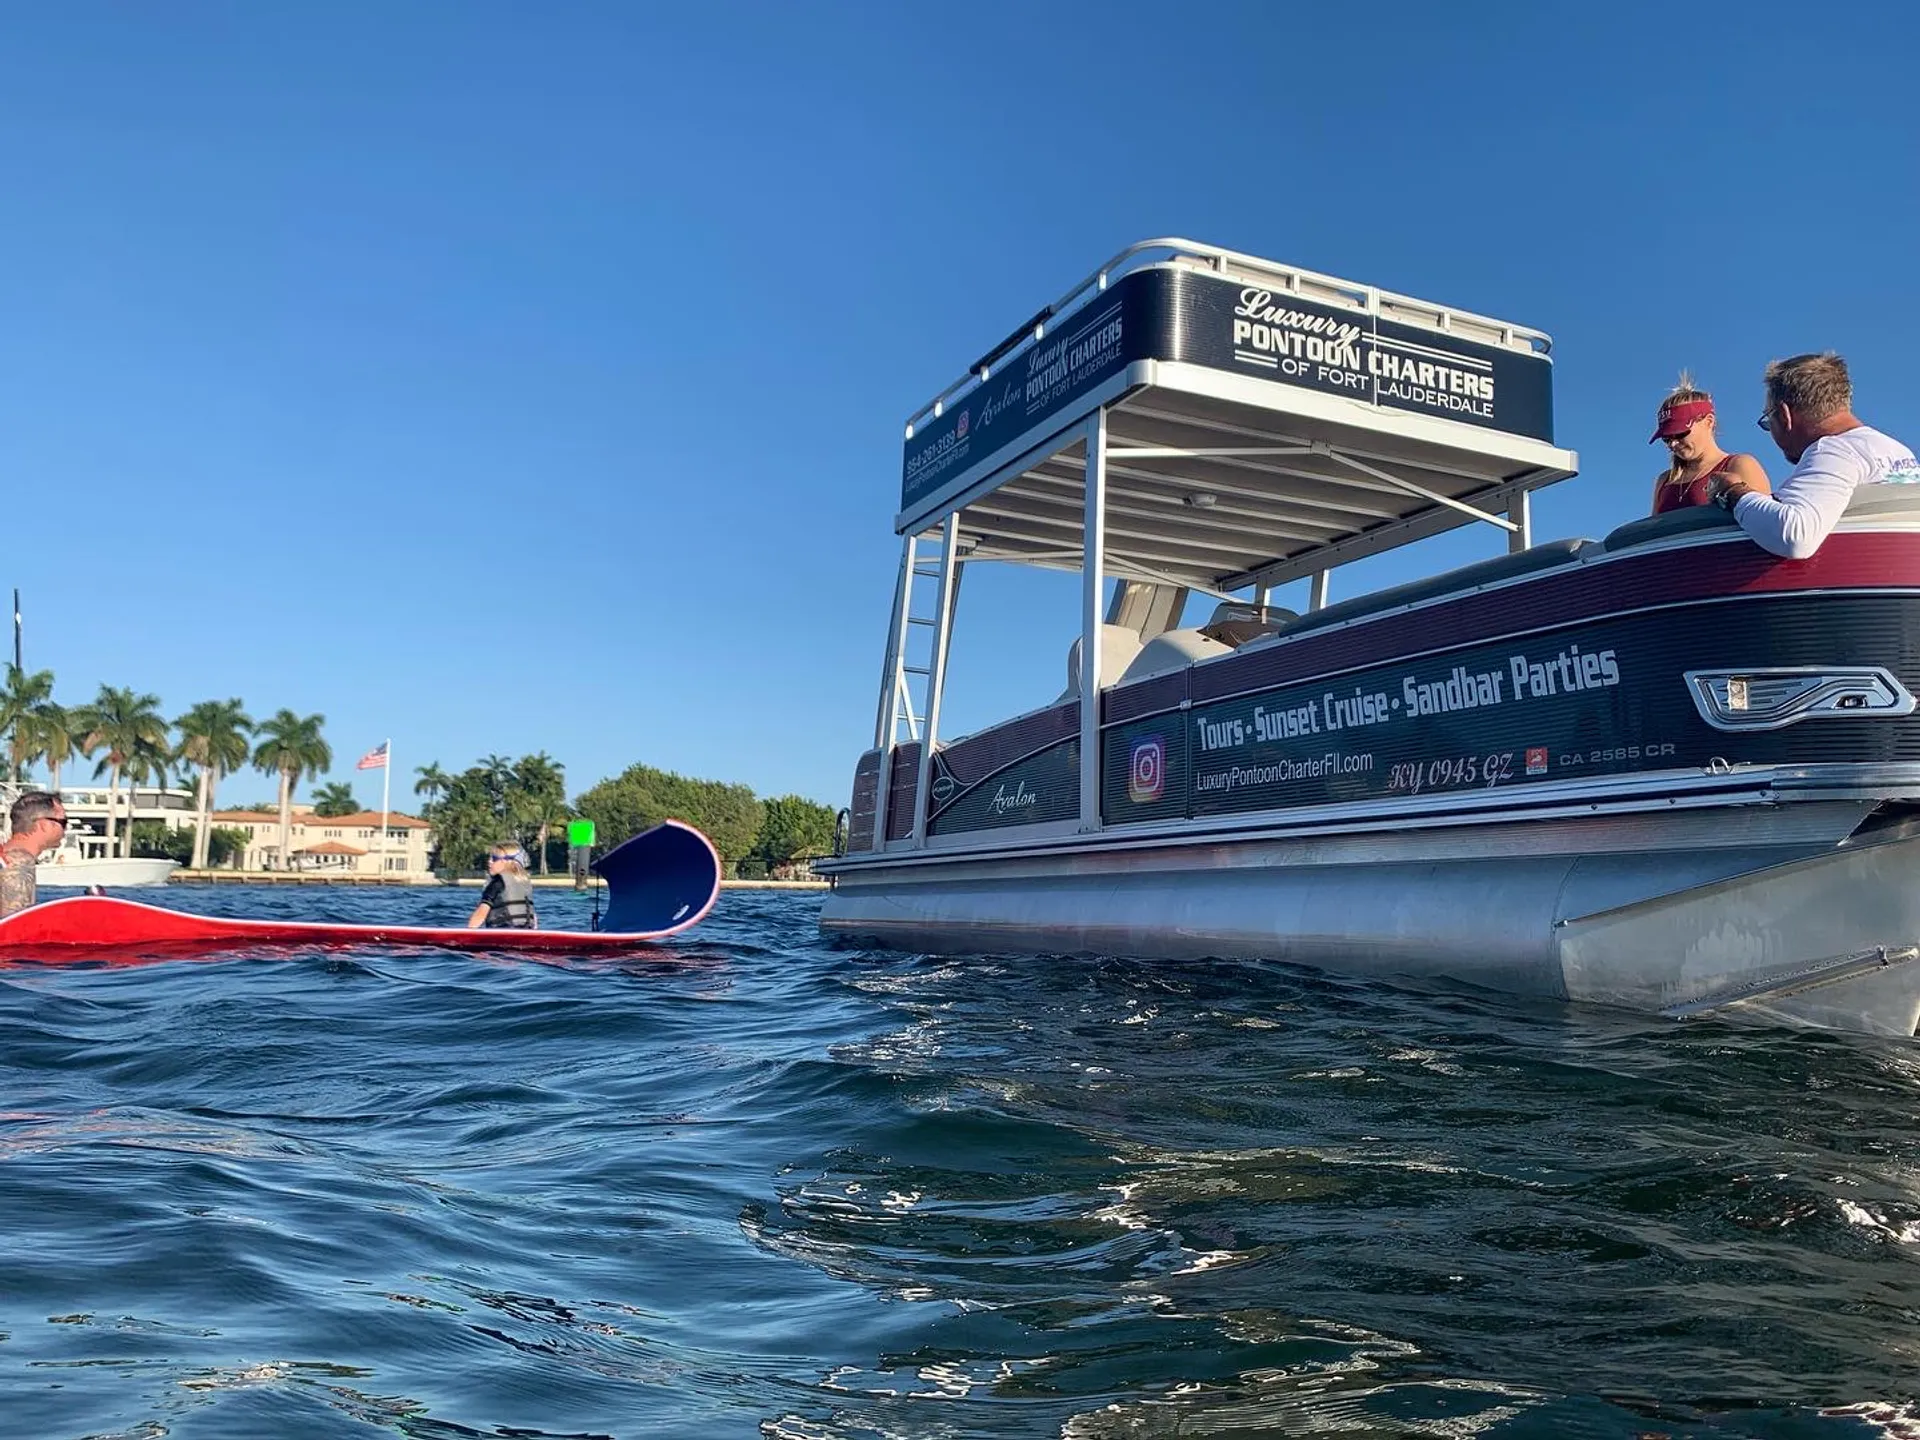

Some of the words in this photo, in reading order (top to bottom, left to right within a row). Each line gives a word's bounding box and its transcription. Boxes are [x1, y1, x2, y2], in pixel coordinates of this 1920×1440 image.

[1234, 288, 1361, 348] Luxury
[1026, 353, 1069, 402] PONTOON
[1070, 316, 1122, 371] CHARTERS
[1027, 337, 1069, 378] Luxury
[1040, 391, 1051, 407] OF
[1052, 376, 1071, 400] FORT
[1072, 342, 1122, 386] LAUDERDALE
[1233, 319, 1361, 371] PONTOON
[1367, 350, 1494, 400] CHARTERS
[1281, 357, 1310, 377] OF
[1318, 367, 1369, 390] FORT
[1376, 378, 1494, 418] LAUDERDALE
[1198, 717, 1244, 750] Tours
[1254, 700, 1320, 742] Sunset
[1323, 687, 1389, 731] Cruise
[1403, 667, 1503, 718] Sandbar
[1510, 645, 1620, 700] Parties
[1388, 762, 1423, 794] KY
[1429, 756, 1477, 785] 0945
[1483, 753, 1514, 787] GZ
[1560, 753, 1584, 766] CA
[1645, 743, 1675, 757] CR
[987, 780, 1035, 814] Avalon
